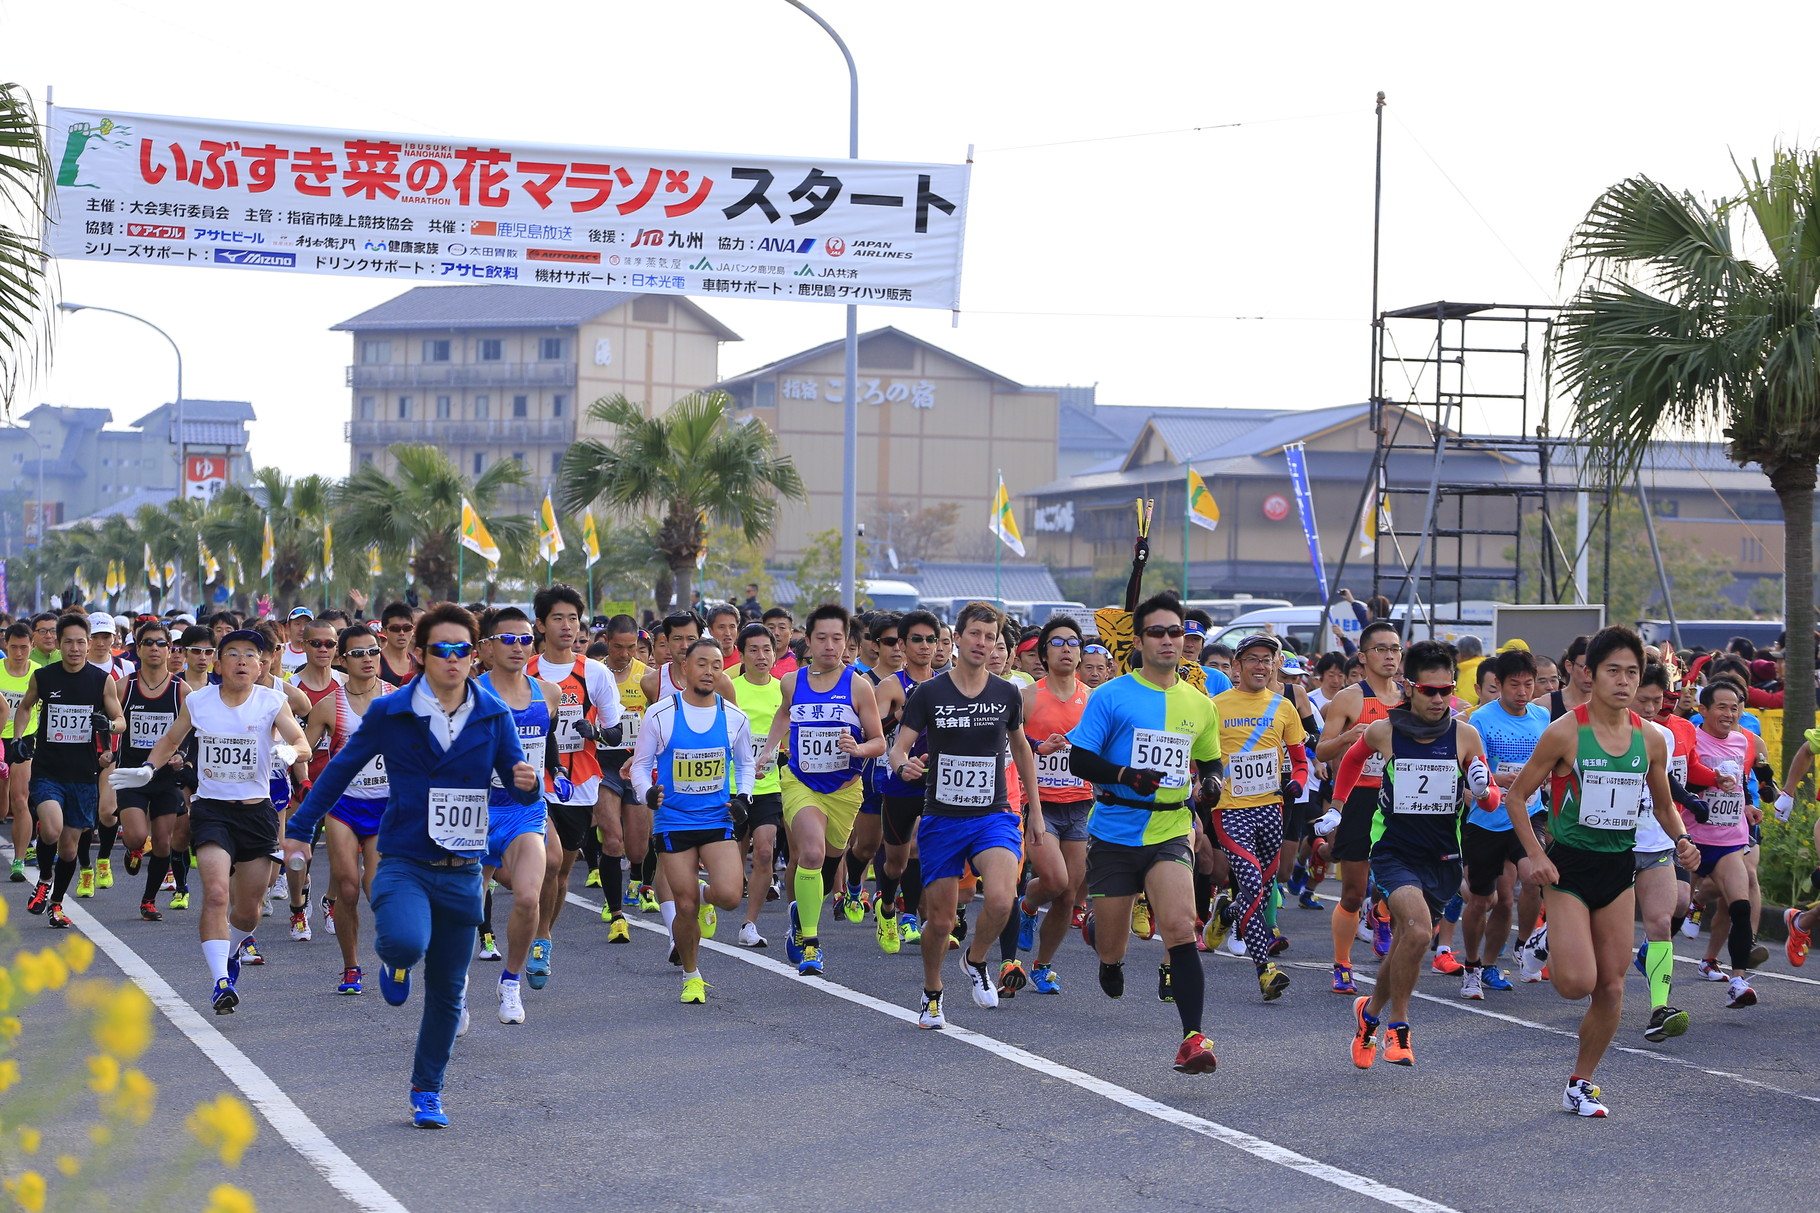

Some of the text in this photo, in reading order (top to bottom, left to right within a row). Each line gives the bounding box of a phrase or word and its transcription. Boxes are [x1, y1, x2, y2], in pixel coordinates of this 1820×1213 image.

[403, 149, 453, 159] NANOHANA
[405, 143, 452, 152] IBUSUKI
[401, 195, 451, 206] MARATHON
[721, 167, 957, 234] スタート
[497, 222, 573, 241] 鹿児島放送
[630, 228, 664, 248] JTB
[668, 230, 703, 249] 九州
[757, 237, 795, 253] ANA
[851, 240, 892, 249] JAPAN
[142, 225, 182, 238] アイフル
[194, 228, 265, 244] アサヒビール
[388, 240, 439, 255] 健康家族
[469, 246, 518, 259] 太田胃散
[540, 251, 599, 261] AUTOBACS
[716, 262, 786, 276] JAバンク鹿児島
[818, 267, 859, 279] JA共済
[853, 249, 913, 259] AIRLINES
[440, 262, 519, 280] アサヒ飲料
[632, 273, 685, 290] 日本光電
[824, 378, 937, 410] ころの宿
[934, 702, 1007, 716] ステープルトン
[51, 714, 87, 729] 5037
[133, 721, 168, 736] 9047
[934, 716, 971, 729] 英会話
[1224, 717, 1275, 728] NUMACCHI
[205, 745, 252, 765] 13034
[1038, 755, 1069, 772] 500
[1137, 744, 1184, 769] 5029
[1582, 758, 1608, 767] 埼玉県庁
[678, 759, 721, 778] 11857
[1234, 760, 1273, 780] 9004
[362, 775, 390, 786] 健康家
[942, 768, 988, 788] 5023
[1037, 776, 1082, 786] アサヒビール
[1418, 774, 1429, 794] 2
[1610, 788, 1616, 808] 1
[435, 805, 481, 828] 5001
